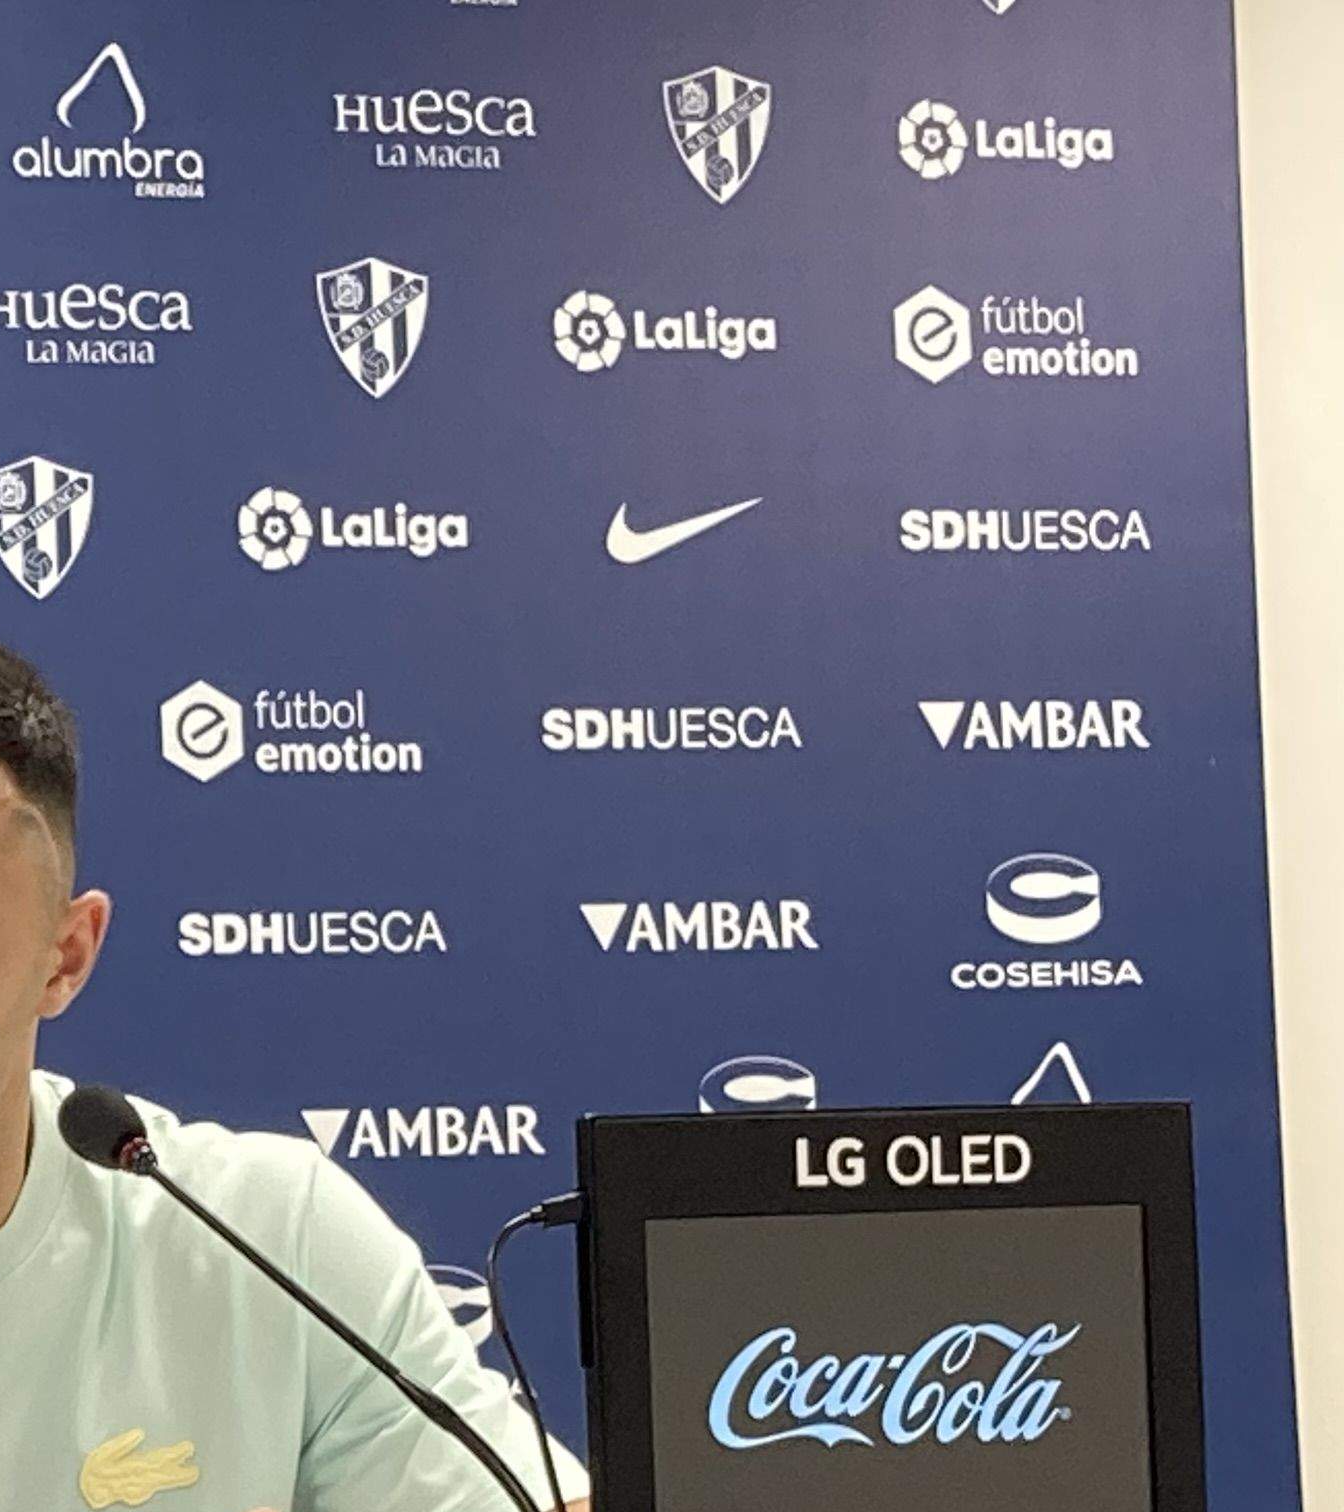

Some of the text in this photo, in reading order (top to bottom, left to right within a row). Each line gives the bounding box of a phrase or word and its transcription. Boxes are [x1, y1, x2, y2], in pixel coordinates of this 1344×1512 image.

[12, 135, 204, 180] alumbra
[975, 116, 1114, 169] LaLiga
[633, 305, 777, 360] LaLiga
[980, 295, 1084, 335] fútbol
[982, 341, 1139, 377] emotion
[321, 502, 468, 557] LaLiga
[900, 509, 1151, 551] SDHUESCA
[253, 689, 365, 730] fútbol
[542, 706, 802, 750] SDHUESCA
[962, 700, 1151, 750] AMBAR
[255, 735, 422, 773] emotion
[179, 910, 447, 956] SDHUESCA
[625, 900, 819, 952] AMBAR
[950, 959, 1144, 989] COSEHISA
[347, 1105, 546, 1158] AMBAR
[795, 1134, 1031, 1187] LG OLED
